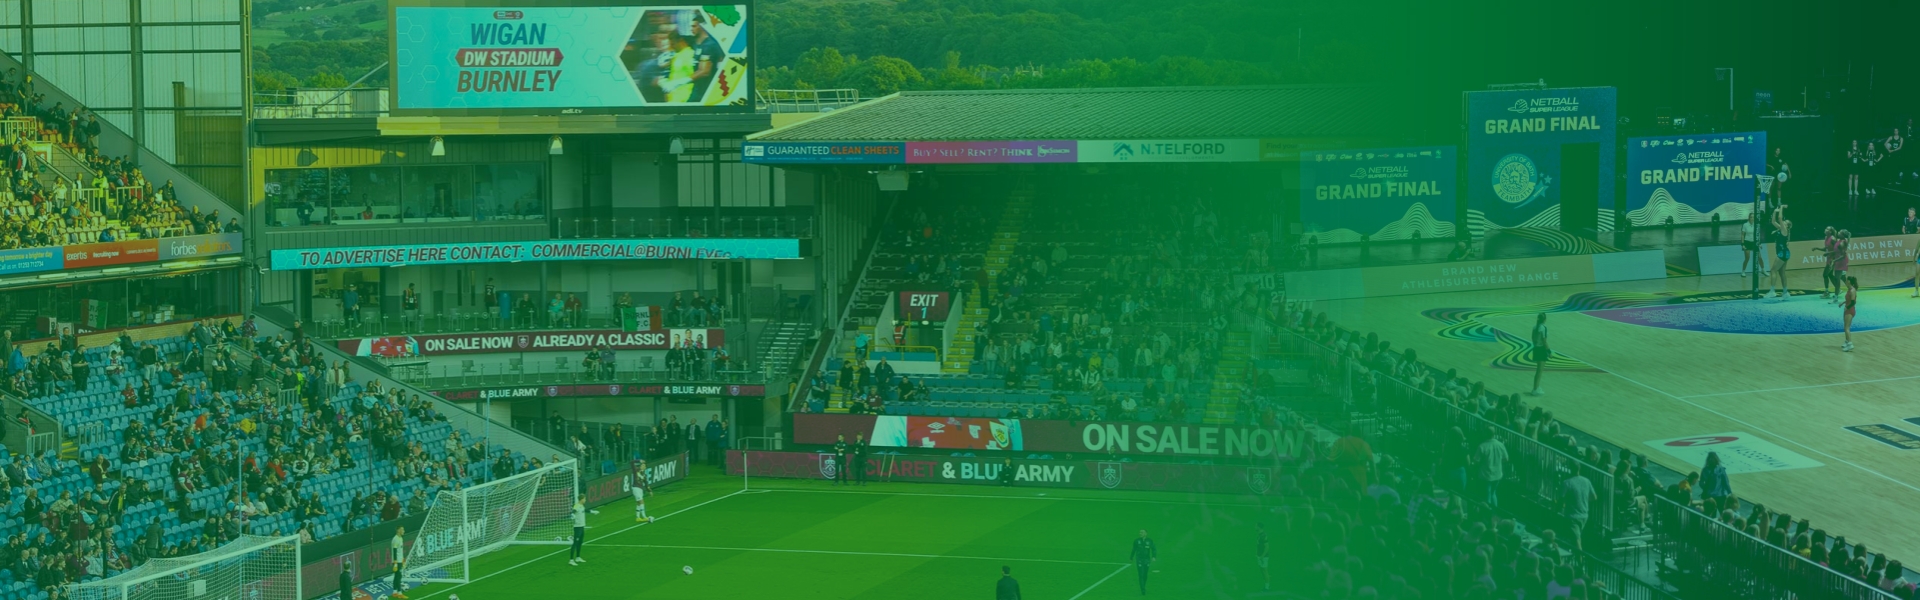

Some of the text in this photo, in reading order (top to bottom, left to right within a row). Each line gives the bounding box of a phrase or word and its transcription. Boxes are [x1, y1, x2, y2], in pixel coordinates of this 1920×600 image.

[470, 23, 547, 45] WIGAN
[464, 51, 555, 66] DW STADIUM
[457, 70, 562, 92] BURNLEY
[1530, 97, 1579, 106] NETBALL
[1485, 116, 1600, 134] GRAND FINAL
[767, 146, 829, 155] GUARANTEED
[830, 146, 861, 155] CLEAN
[864, 146, 899, 155] SHEETS
[1140, 143, 1225, 155] N.TELFORD
[1687, 151, 1724, 159] NETBALL
[1494, 155, 1519, 179] UNIVERSITY
[1525, 161, 1535, 177] BATH
[1640, 165, 1753, 185] GRAND FINAL
[1315, 181, 1441, 201] GRAND FINAL
[1497, 187, 1533, 202] TEAMBATH
[170, 241, 197, 256] forbes
[1880, 239, 1903, 249] NEW
[28, 252, 45, 260] brighter
[45, 251, 53, 259] day
[301, 252, 320, 265] TO
[323, 248, 406, 265] ADVERTISE
[408, 247, 448, 262] HERE
[450, 245, 525, 260] CONTACT:
[1442, 264, 1517, 276] BRAND NEW
[1401, 272, 1559, 290] ATHLEISUREWEAR RANGE
[910, 294, 939, 307] EXIT
[921, 307, 927, 319] 1
[425, 333, 665, 351] ON SALE NOW ALREADY A CLASSIC
[445, 388, 538, 401] CLARET & BLUE ARMY
[628, 385, 722, 394] CLARET & BLUE ARMY
[1082, 423, 1306, 458] ON SALE NOW
[653, 460, 678, 483] ARMY
[865, 459, 1075, 483] CLARET & BLU ARMY
[587, 476, 623, 503] CLARET
[623, 475, 630, 492] &
[416, 517, 488, 557] & BLUE ARMY
